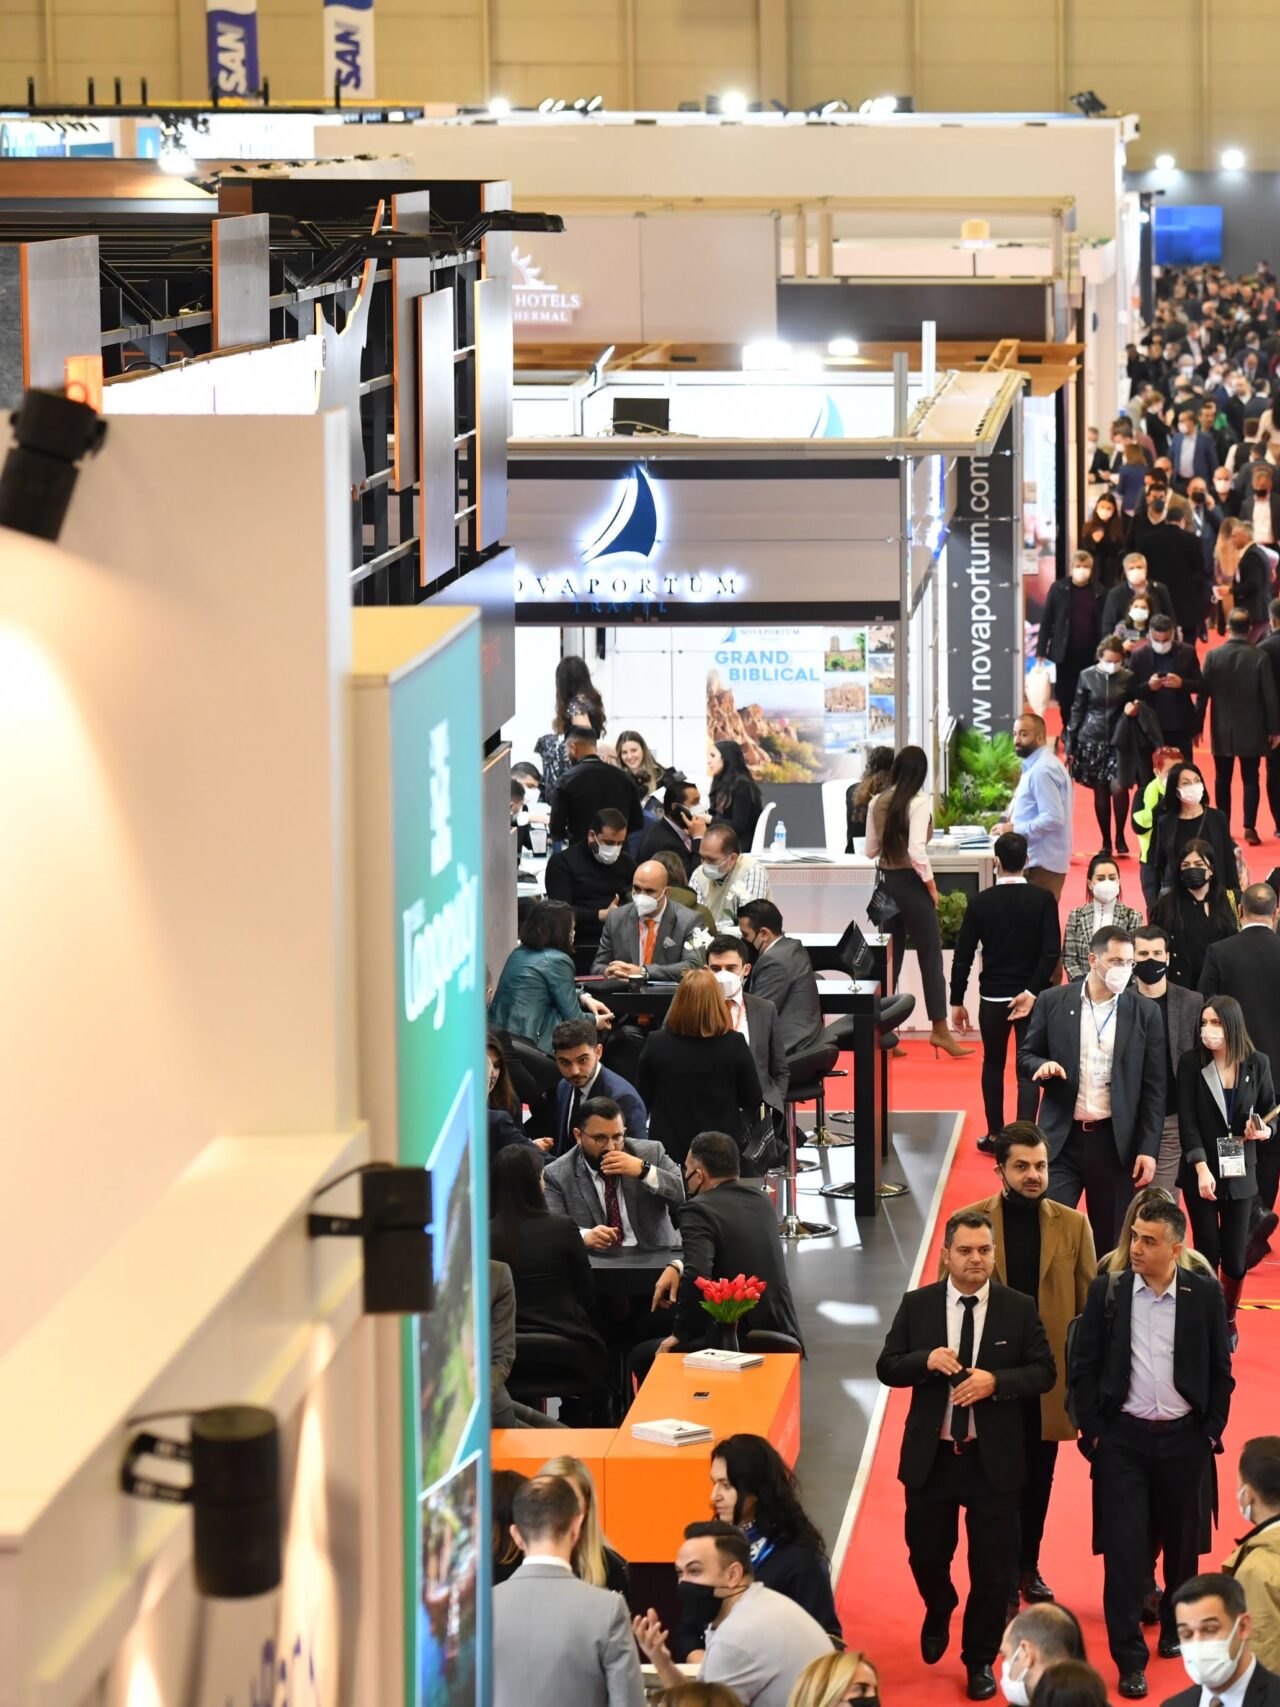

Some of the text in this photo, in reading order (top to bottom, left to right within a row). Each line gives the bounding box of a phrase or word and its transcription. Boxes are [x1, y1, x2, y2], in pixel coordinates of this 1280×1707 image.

[515, 293, 580, 308] HOTELS
[513, 311, 568, 321] HERMAL
[517, 576, 737, 595] VAPORTUM
[715, 651, 789, 664] GRAND
[729, 668, 820, 681] BIBLICAL
